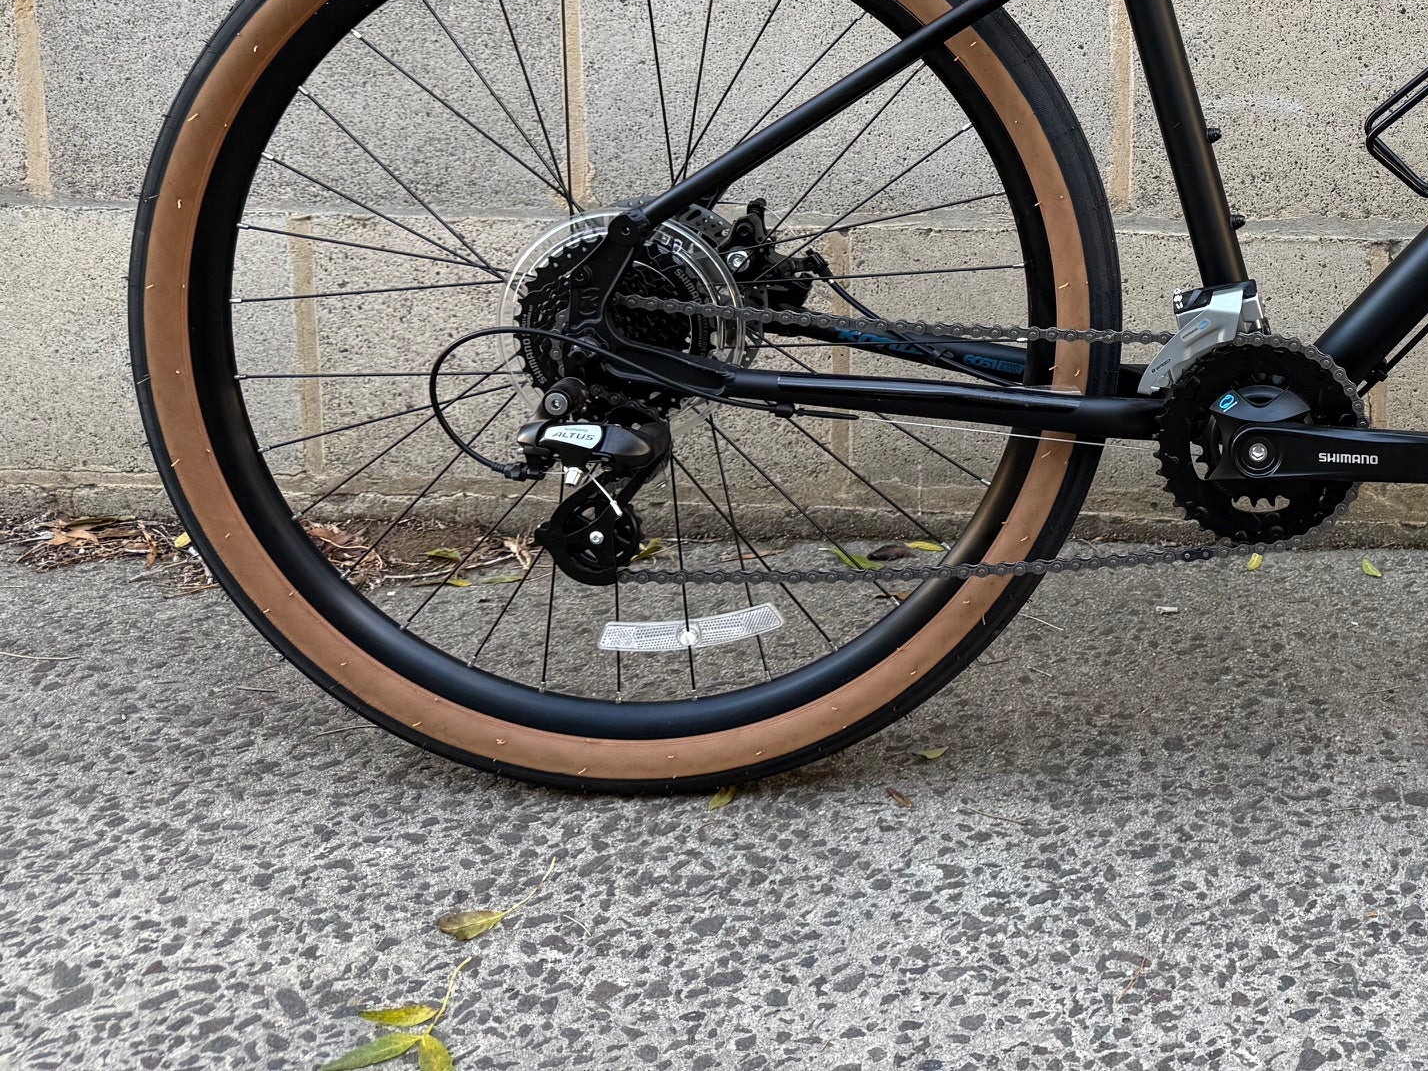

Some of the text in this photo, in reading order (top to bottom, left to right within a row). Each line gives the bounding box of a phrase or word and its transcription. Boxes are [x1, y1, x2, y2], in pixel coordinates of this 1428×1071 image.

[674, 268, 702, 304] SHIMAN
[522, 338, 548, 385] SHIMANO
[552, 431, 595, 441] ALTUS
[1318, 452, 1379, 465] SHIMANO
